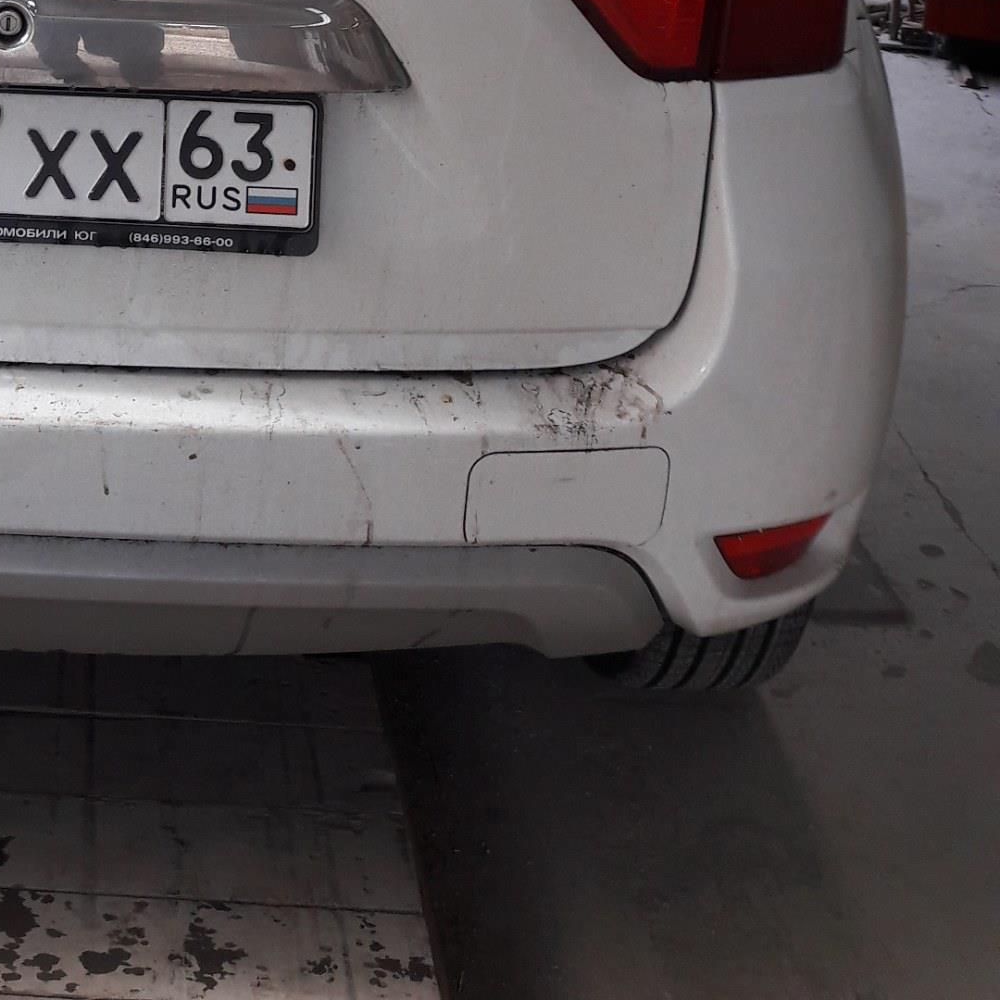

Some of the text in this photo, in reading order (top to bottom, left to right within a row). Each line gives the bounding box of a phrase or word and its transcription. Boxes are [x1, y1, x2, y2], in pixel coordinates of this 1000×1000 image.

[178, 109, 274, 182] 63
[171, 184, 242, 211] RUS
[74, 229, 98, 242] ЮГ
